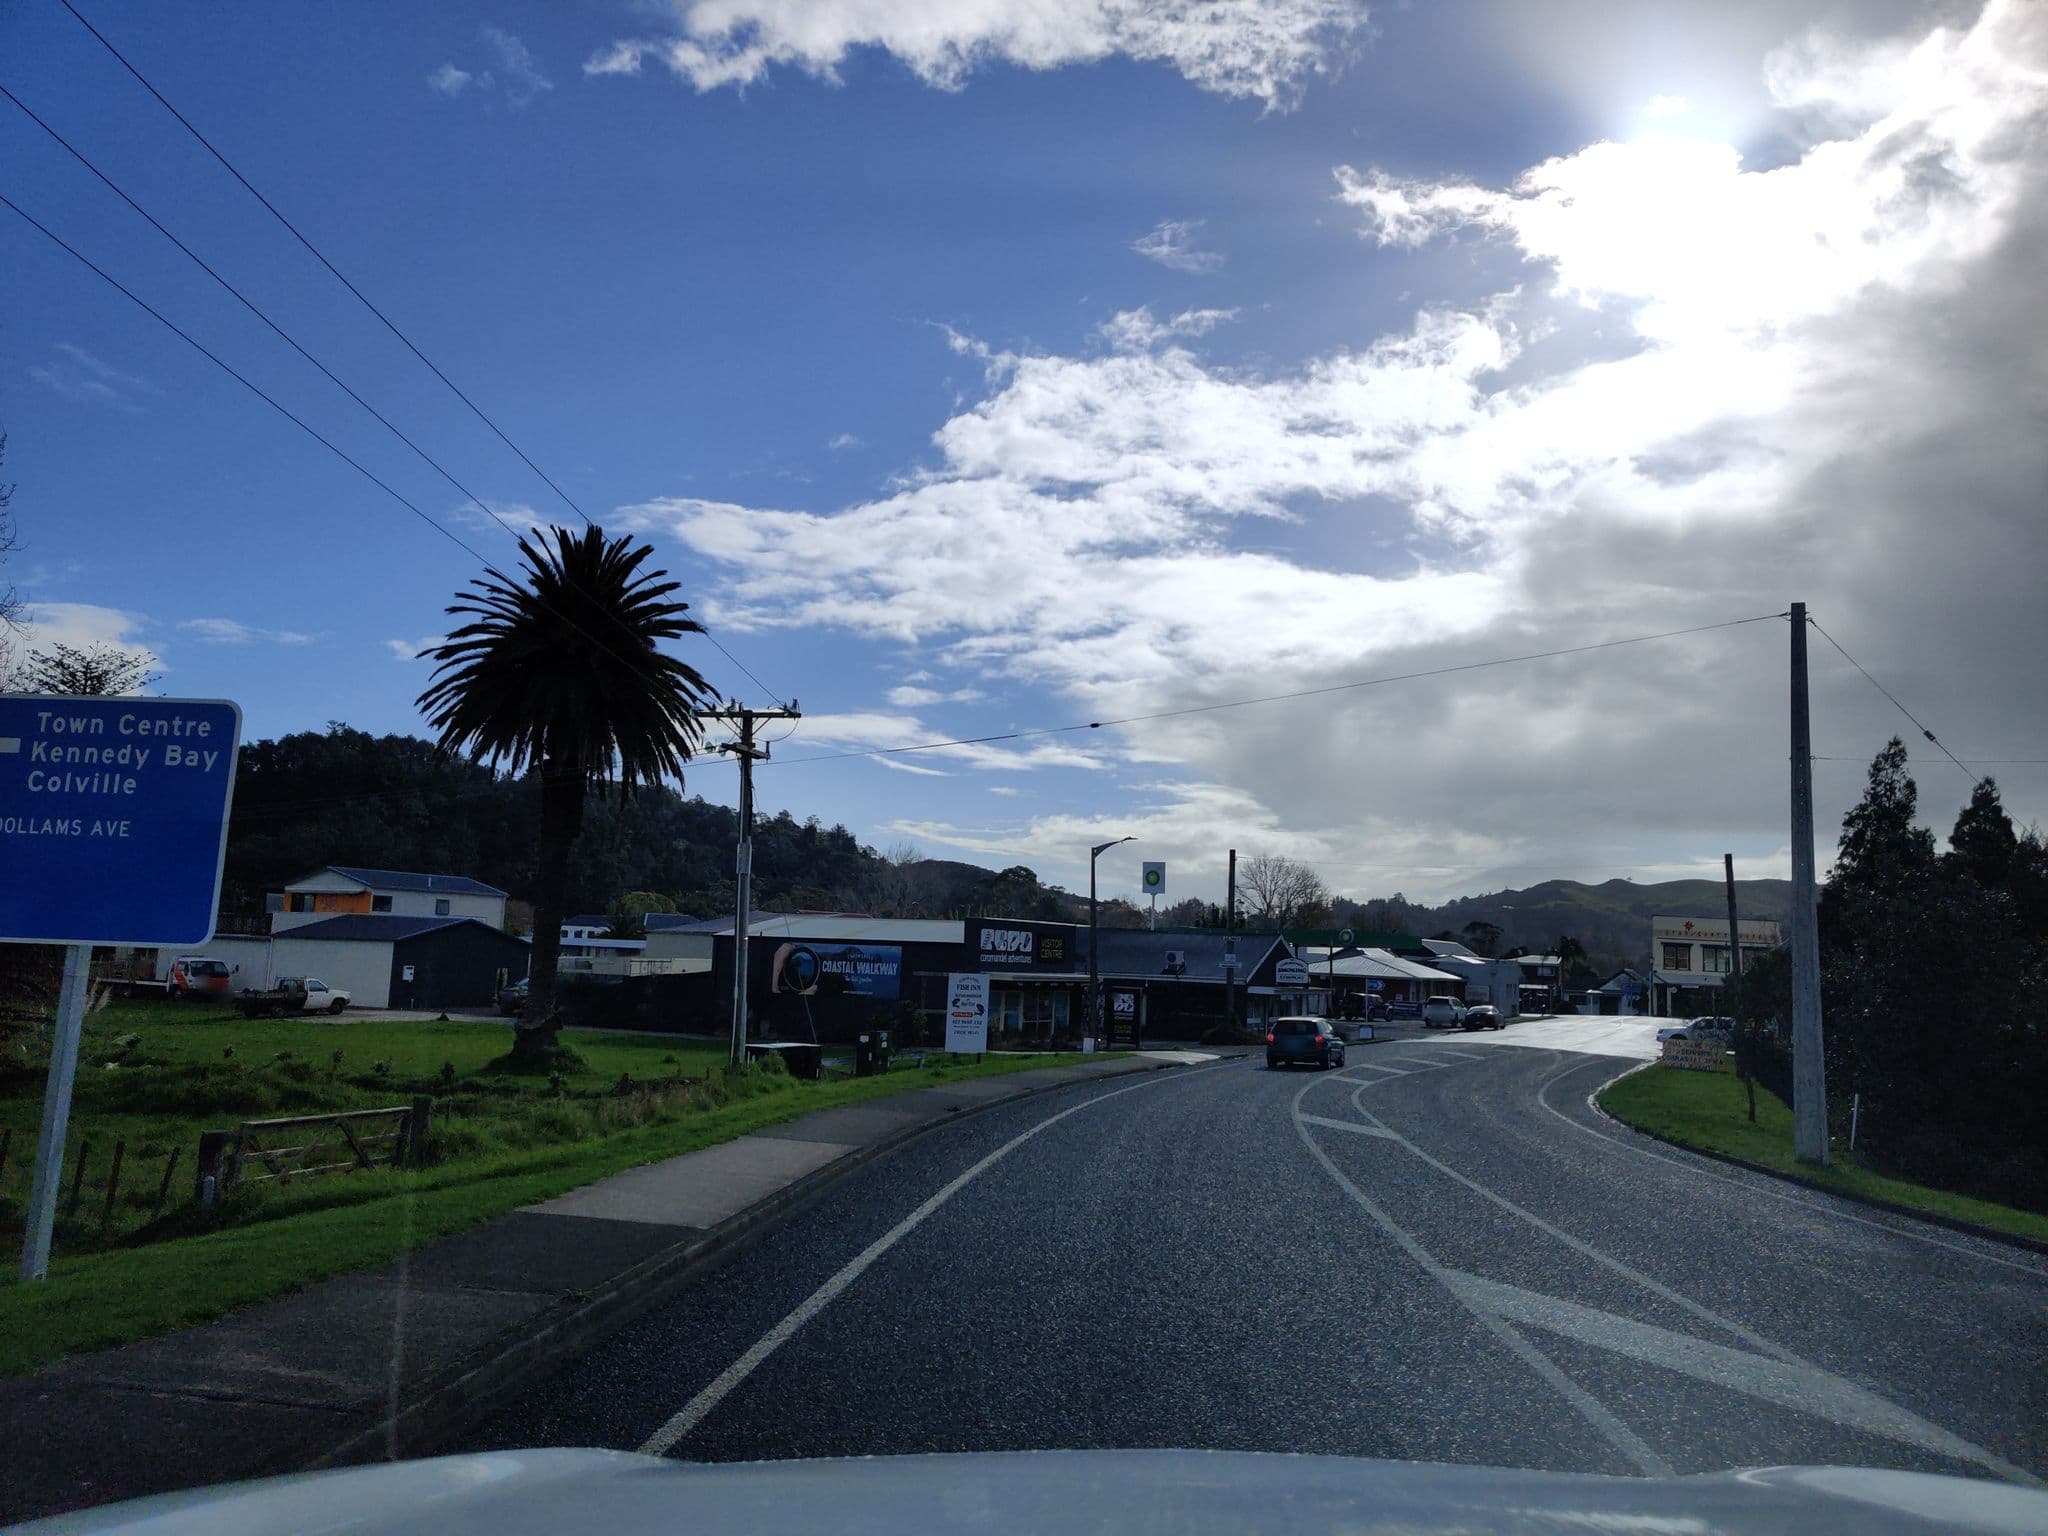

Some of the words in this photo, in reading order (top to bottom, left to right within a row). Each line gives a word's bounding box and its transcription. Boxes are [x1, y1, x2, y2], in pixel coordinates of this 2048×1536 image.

[38, 711, 104, 735] Town
[119, 713, 211, 737] Centre
[31, 740, 150, 770] Kennedy
[164, 744, 218, 772] Bay
[27, 770, 137, 794] Colville
[90, 819, 131, 837] AVE
[1040, 948, 1064, 960] CENTRE
[822, 960, 856, 974] COASTAL
[856, 961, 898, 976] WALKWAY
